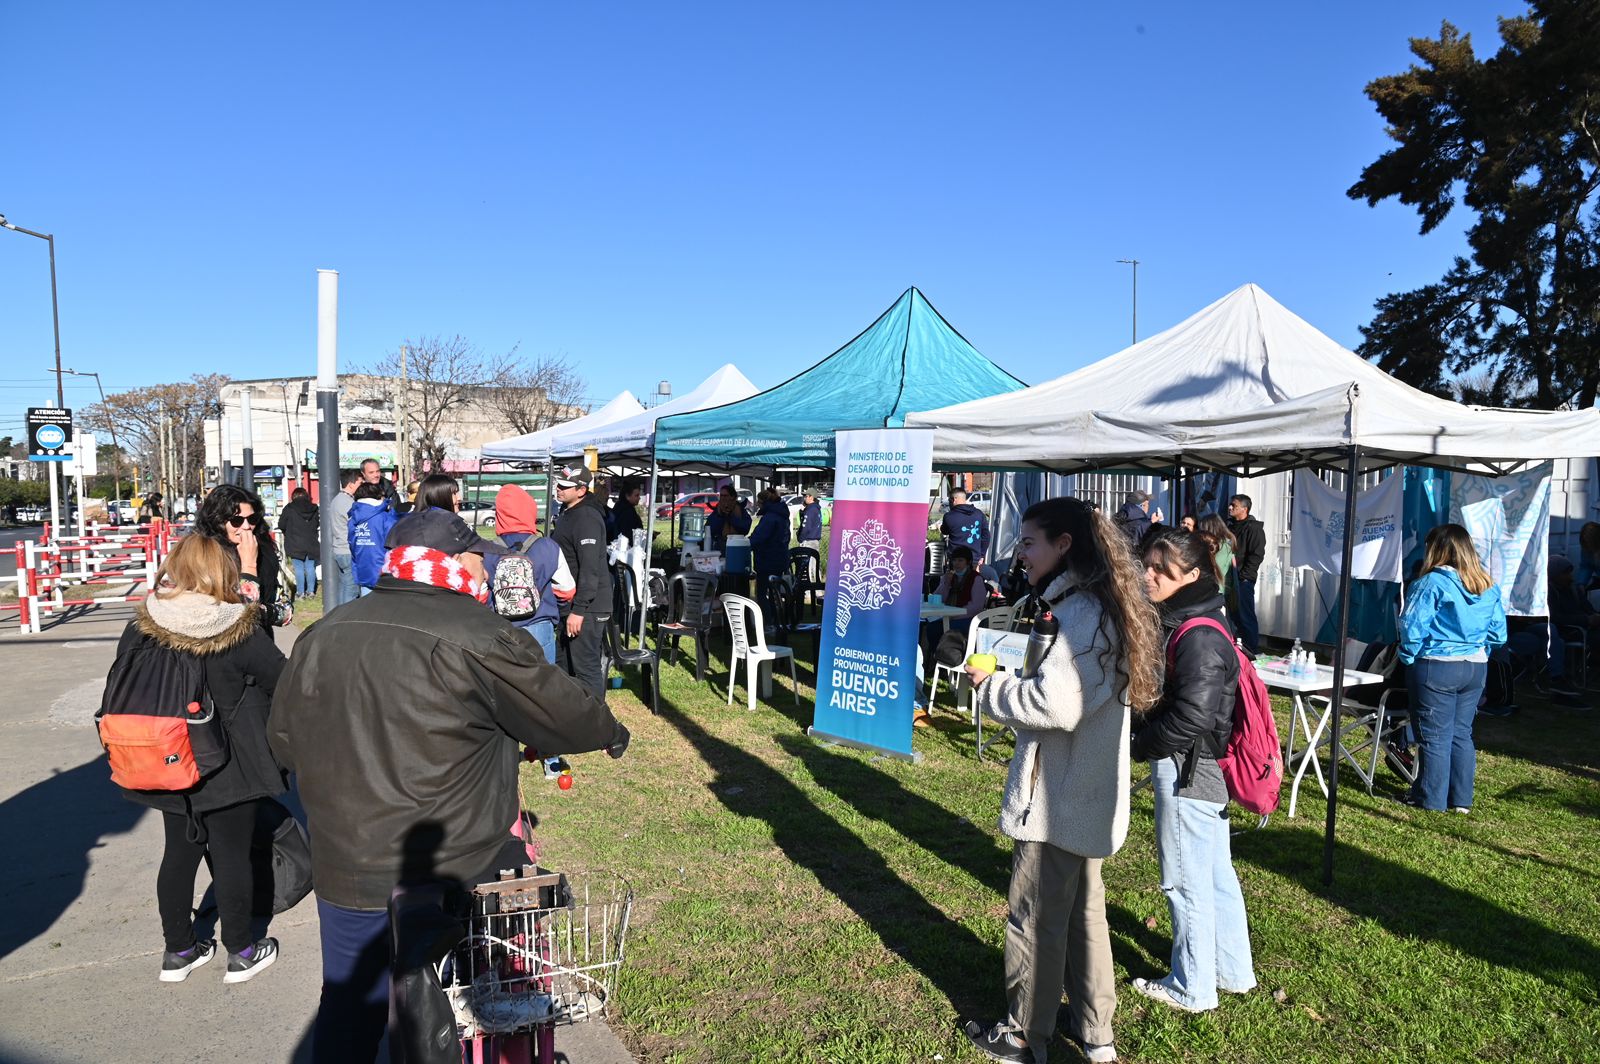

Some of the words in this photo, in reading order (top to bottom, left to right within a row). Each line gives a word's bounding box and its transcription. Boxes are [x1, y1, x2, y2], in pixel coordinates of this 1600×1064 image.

[734, 438, 742, 447] DE
[742, 439, 749, 447] LA
[750, 439, 787, 449] COMUNIDAD
[849, 452, 893, 461] MINISTERIO
[895, 452, 906, 461] DE
[848, 465, 900, 474] DESARROLLO
[902, 465, 913, 474] DE
[847, 477, 857, 486] LA
[859, 478, 909, 487] COMUNIDAD
[834, 646, 875, 661] GOBIERNO
[876, 654, 888, 665] DE
[889, 656, 900, 667] LA
[833, 658, 875, 674] PROVINCIA
[876, 666, 888, 677] DE
[832, 669, 899, 699] BUENOS
[829, 690, 877, 716] AIRES
